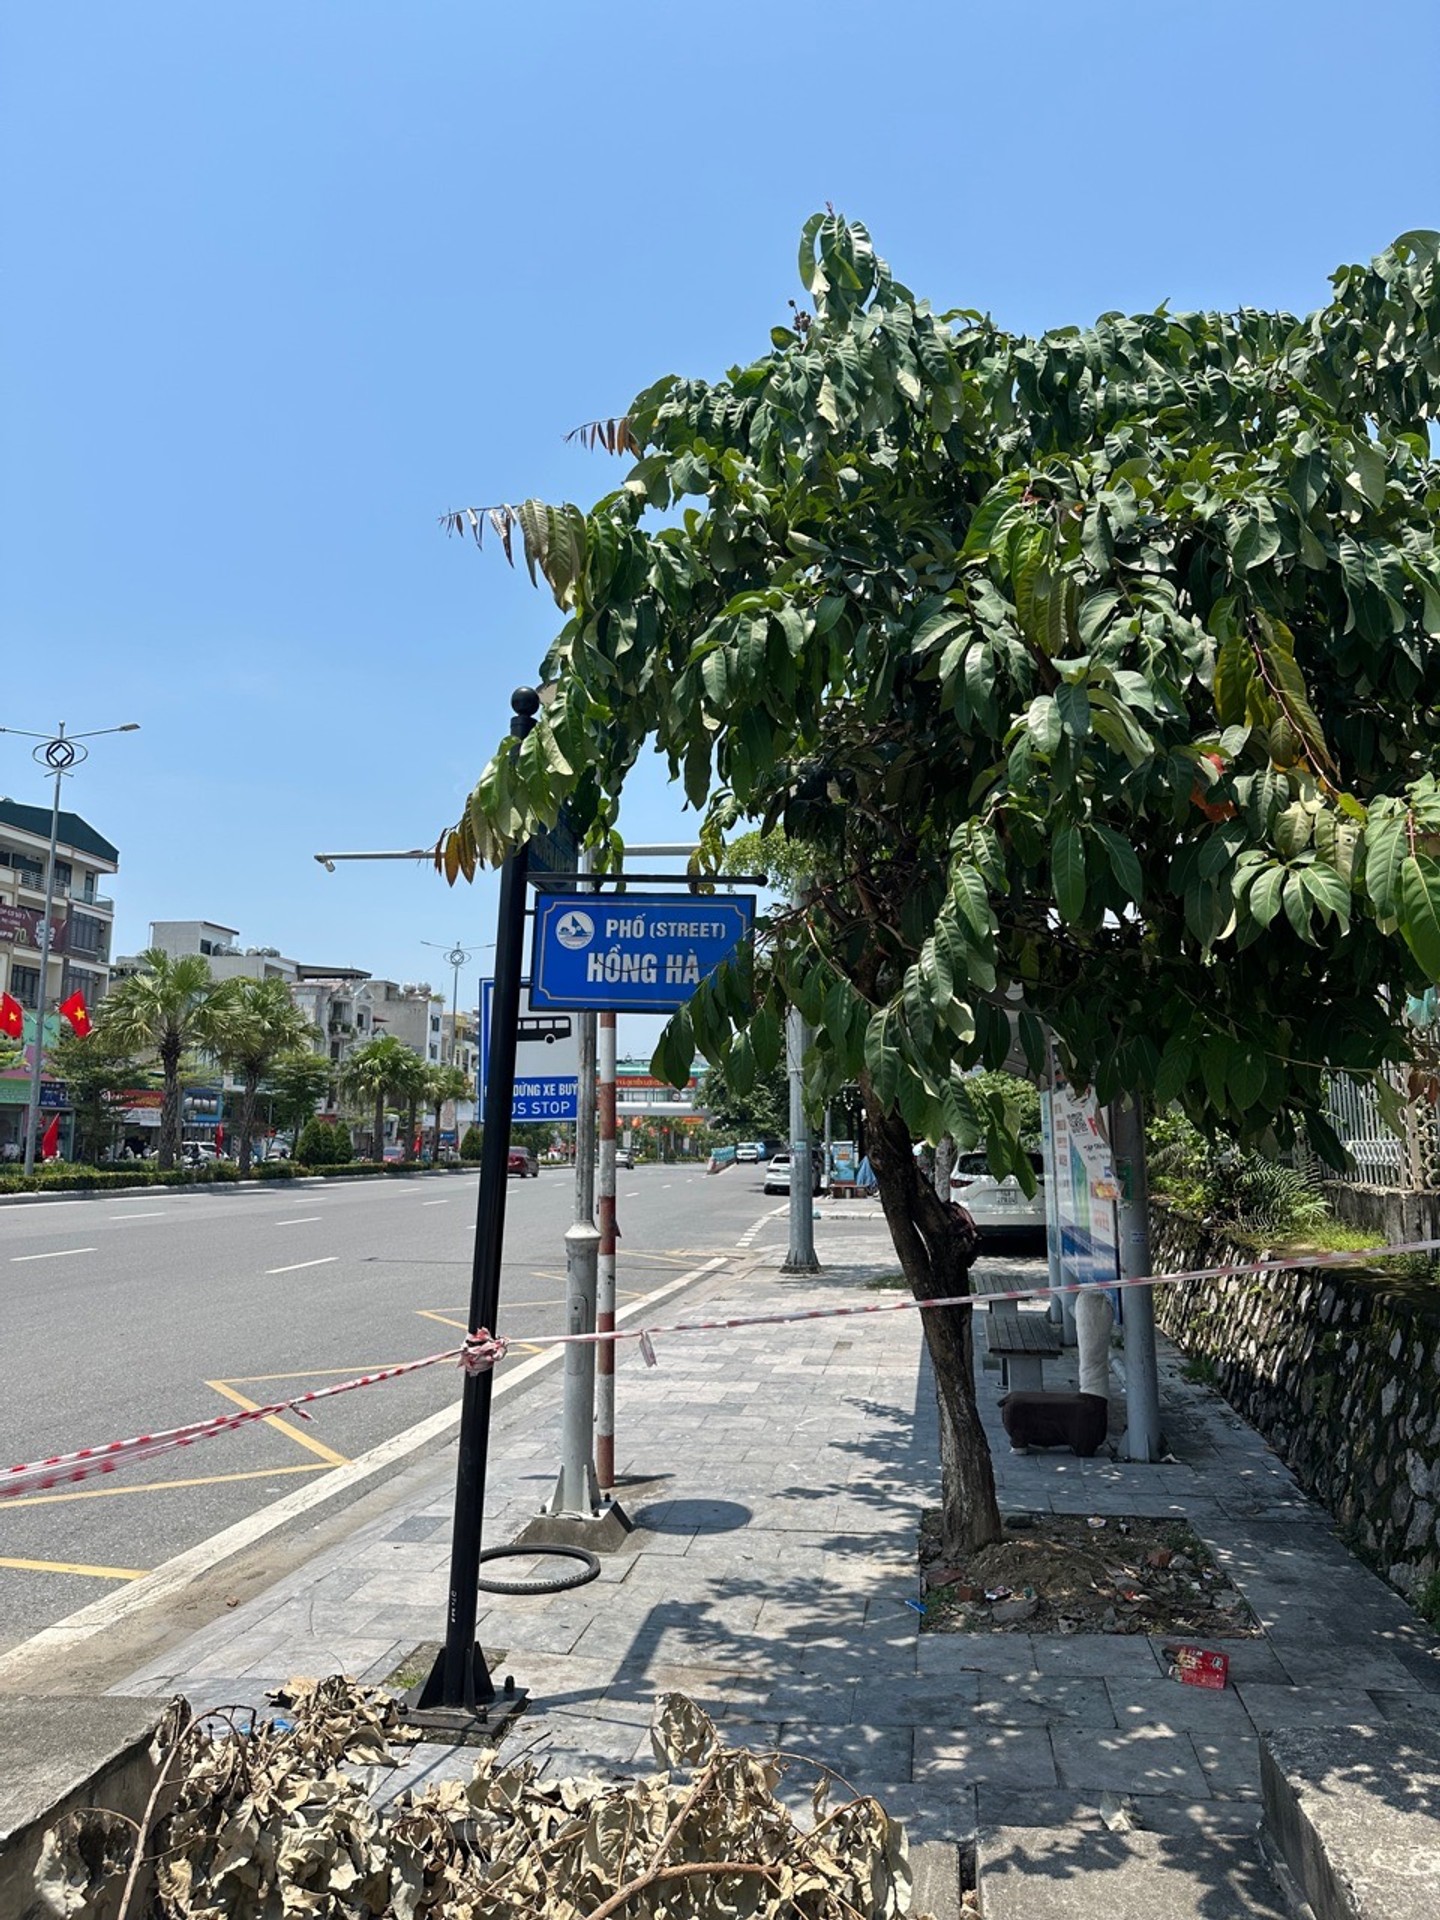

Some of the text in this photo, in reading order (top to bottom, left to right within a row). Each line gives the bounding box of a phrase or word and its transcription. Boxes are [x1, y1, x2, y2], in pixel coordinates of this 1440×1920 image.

[606, 913, 726, 939] PHỐ (STREET)
[587, 944, 700, 984] HỒNG HÀ
[543, 1083, 556, 1096] XE
[559, 1080, 578, 1096] BUÝ
[532, 1101, 570, 1114] STOP
